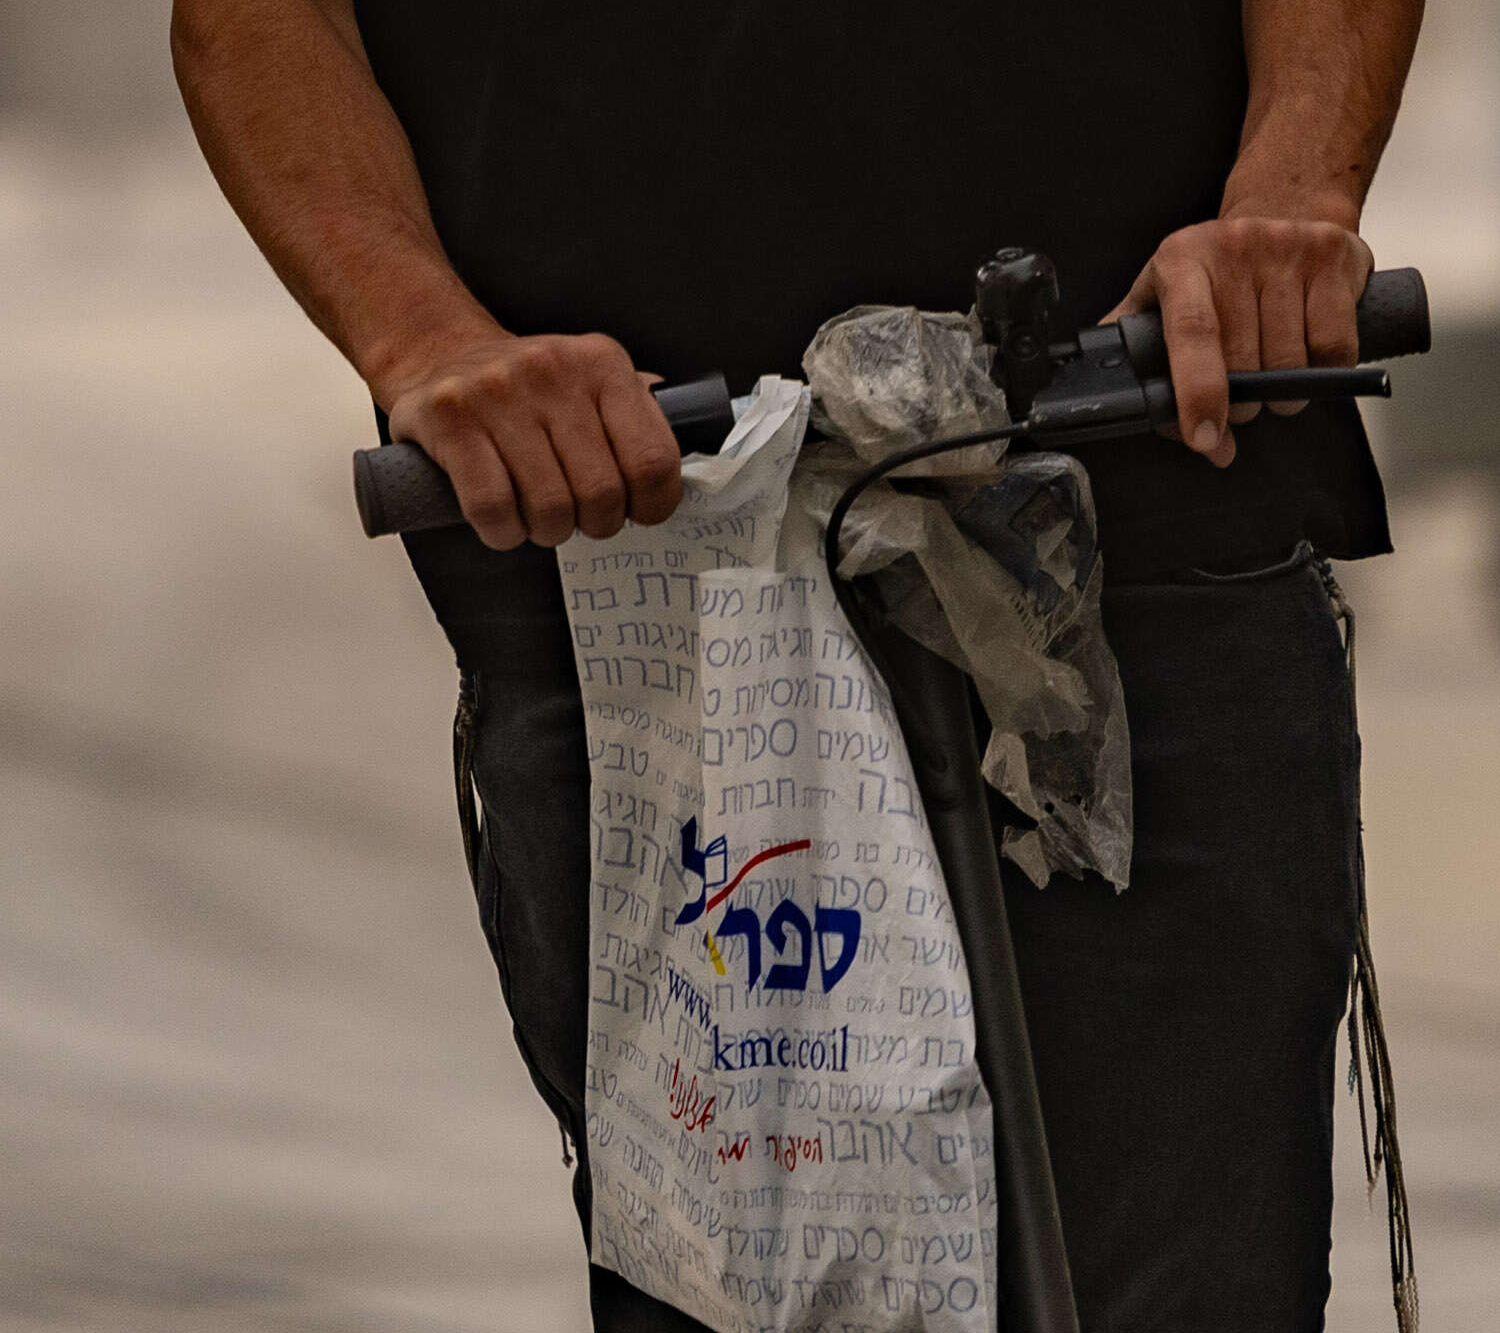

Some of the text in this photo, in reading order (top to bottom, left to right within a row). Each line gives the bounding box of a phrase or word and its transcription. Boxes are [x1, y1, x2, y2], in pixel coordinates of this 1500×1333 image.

[590, 551, 654, 574] הולדת
[572, 586, 620, 612] בת
[574, 624, 602, 648] ים
[584, 655, 696, 704] חברות
[702, 718, 890, 766] שמים ספרים
[718, 777, 797, 817] חברות
[854, 841, 881, 864] בת
[919, 1035, 965, 1068] בת
[895, 1084, 964, 1115] טבע
[802, 1223, 885, 1263] ספרים
[901, 1232, 974, 1265] שמים
[880, 1274, 978, 1314] ספרים
